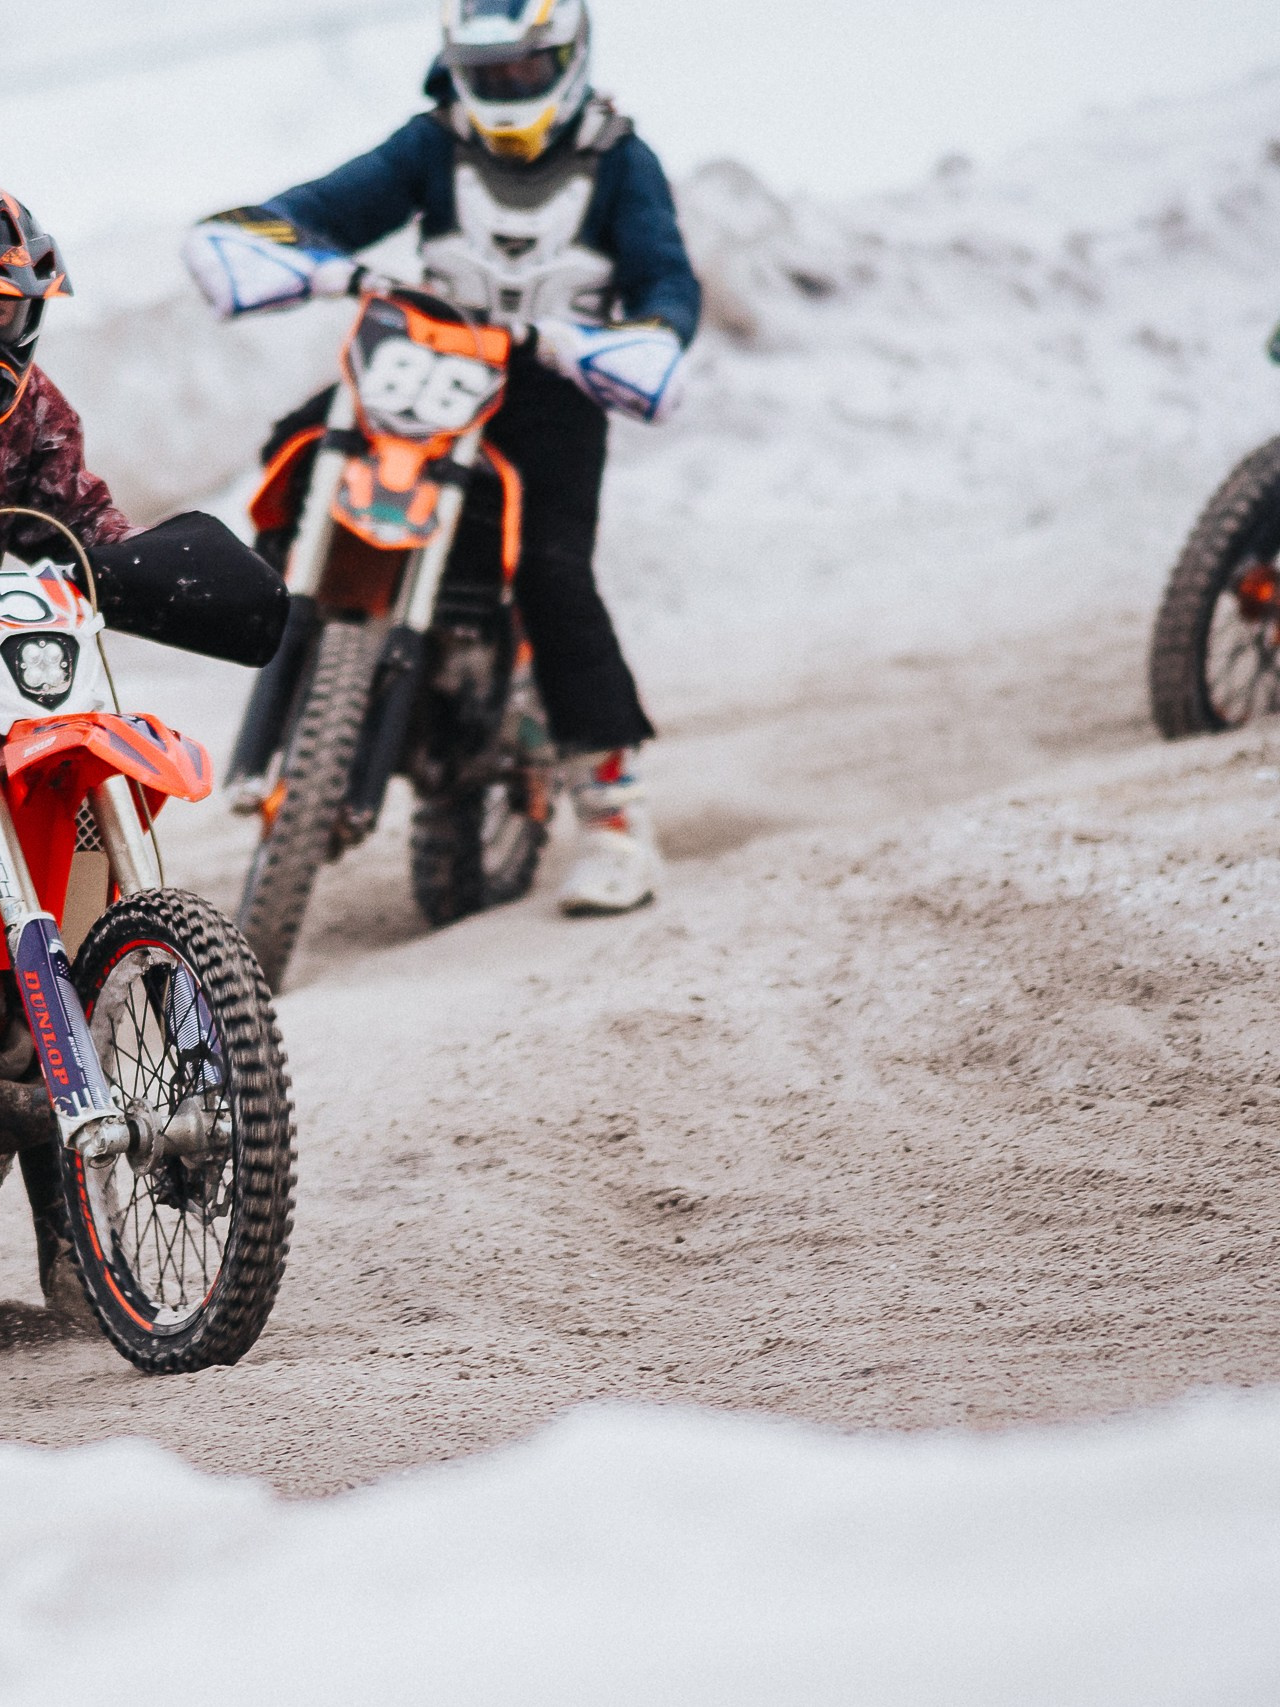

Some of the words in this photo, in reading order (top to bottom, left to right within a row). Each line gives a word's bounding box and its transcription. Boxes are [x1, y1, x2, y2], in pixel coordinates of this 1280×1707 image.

[361, 336, 488, 428] 86
[23, 970, 70, 1086] DUNLOP
[68, 1035, 84, 1069] DUNLOP
